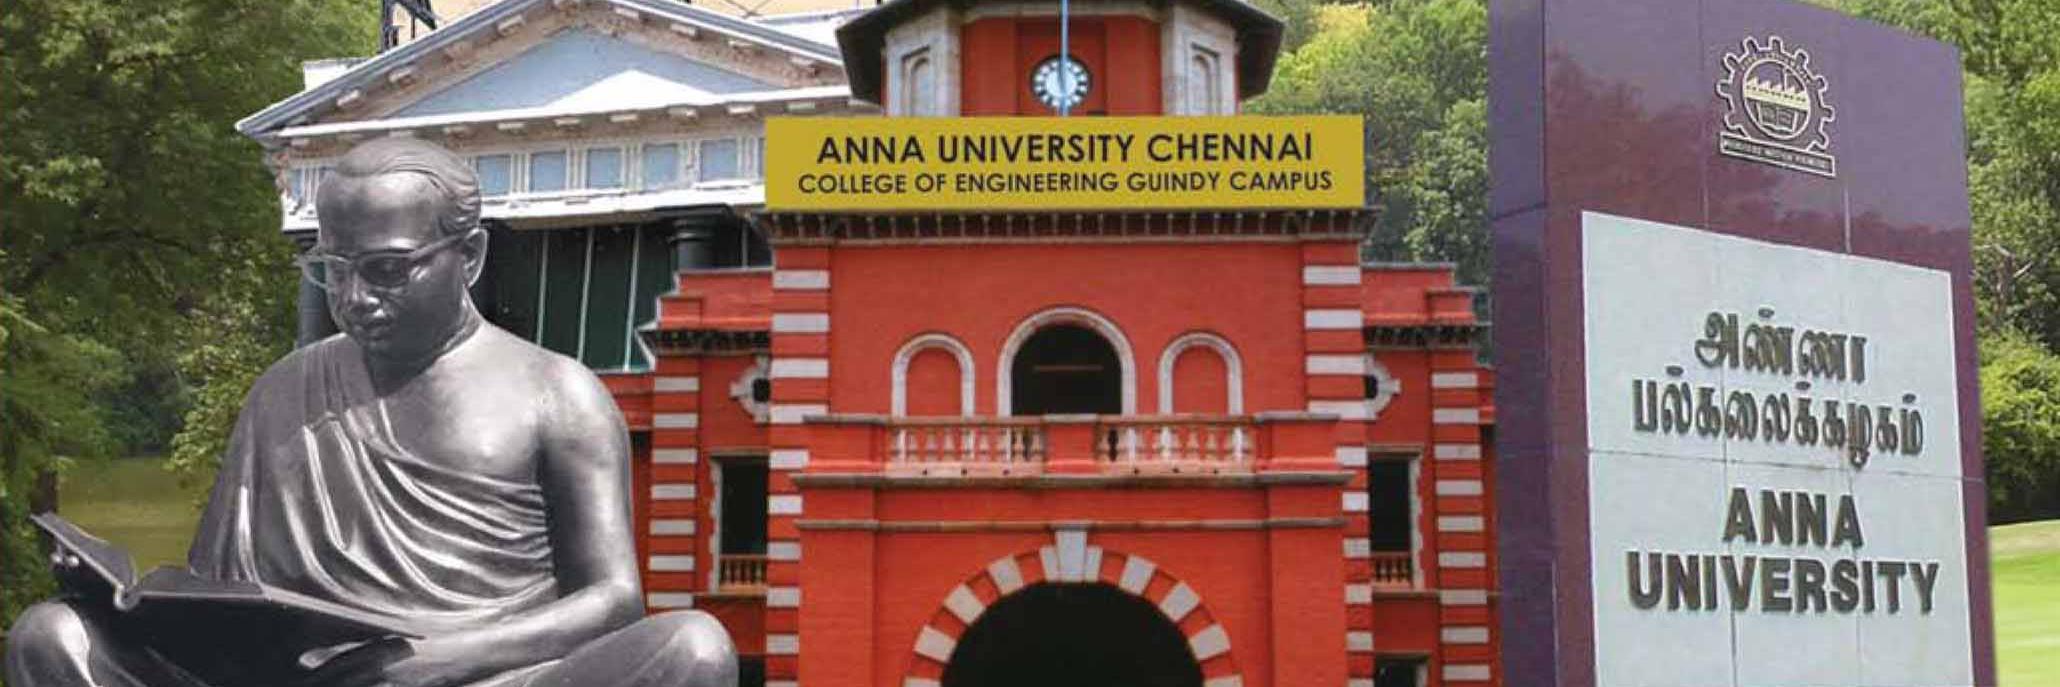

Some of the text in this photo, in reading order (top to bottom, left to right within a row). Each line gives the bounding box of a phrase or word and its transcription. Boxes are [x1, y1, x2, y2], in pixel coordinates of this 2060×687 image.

[817, 133, 1312, 164] ANNA UNIVERSITY CHENNAI
[799, 171, 1332, 194] COLLEGE OF ENGINEERING GUINDY CAMPUS
[1694, 307, 1868, 383] அண்ணா
[1632, 365, 1924, 469] பல்கலைக்கழகம்
[1722, 487, 1863, 548] ANNA
[1626, 551, 1939, 614] UNIVERSITY
